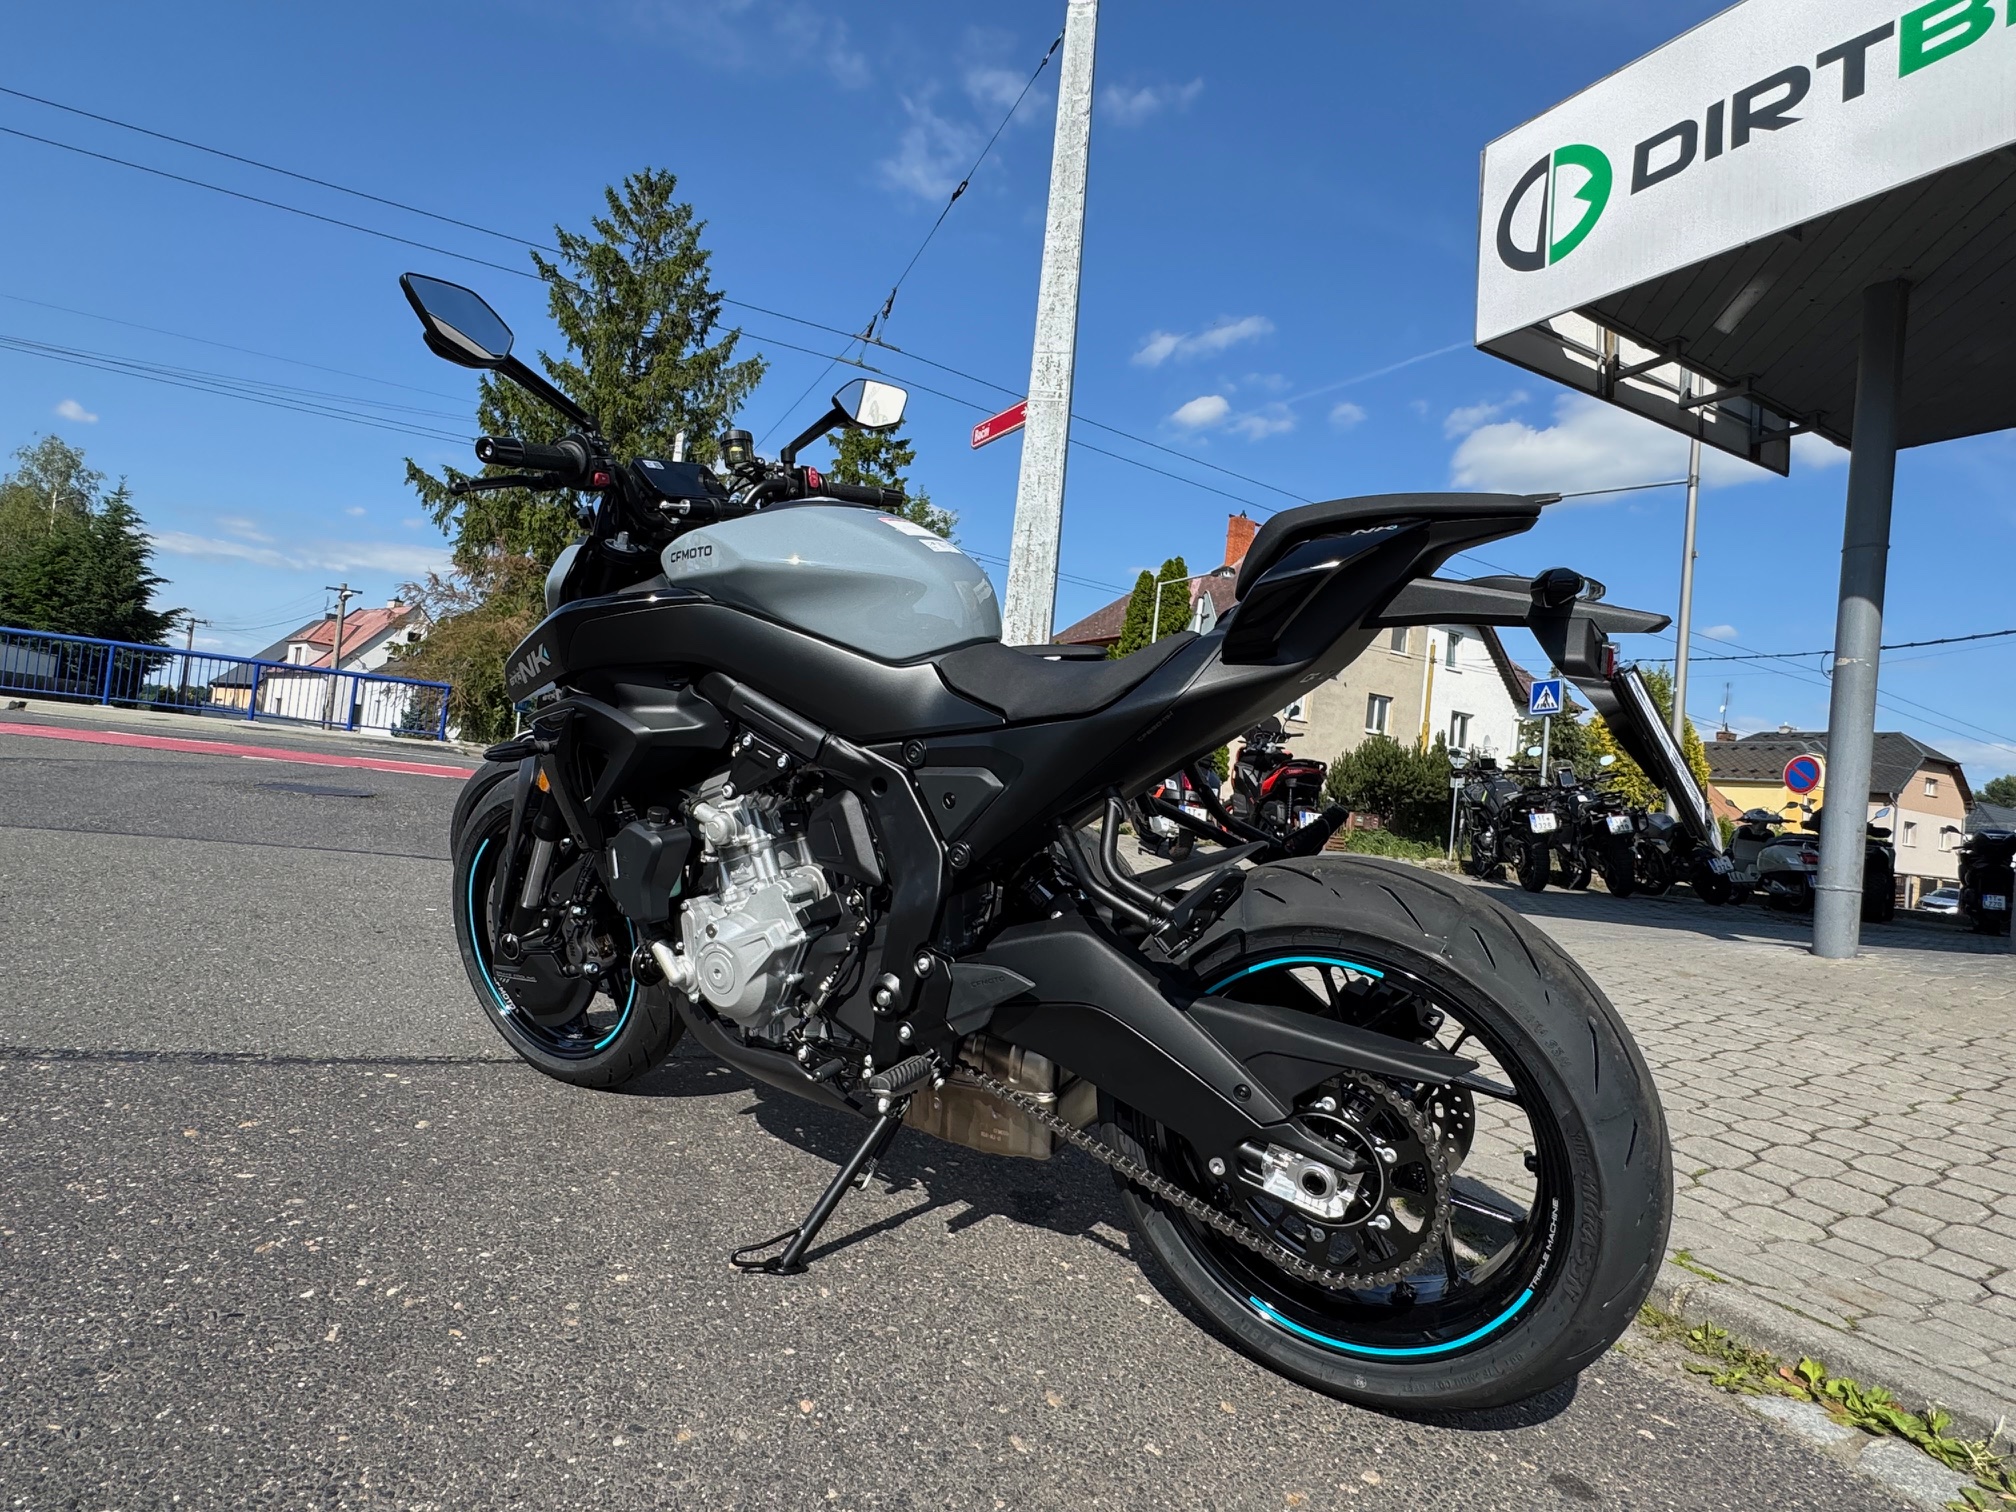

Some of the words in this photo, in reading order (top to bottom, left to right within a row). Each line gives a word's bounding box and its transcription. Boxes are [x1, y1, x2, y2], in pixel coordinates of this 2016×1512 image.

[1631, 0, 2016, 195] DIRTB
[670, 544, 713, 563] CFMOTO
[1529, 1253, 1550, 1290] TRIPLE
[1547, 1196, 1560, 1252] MACHINE
